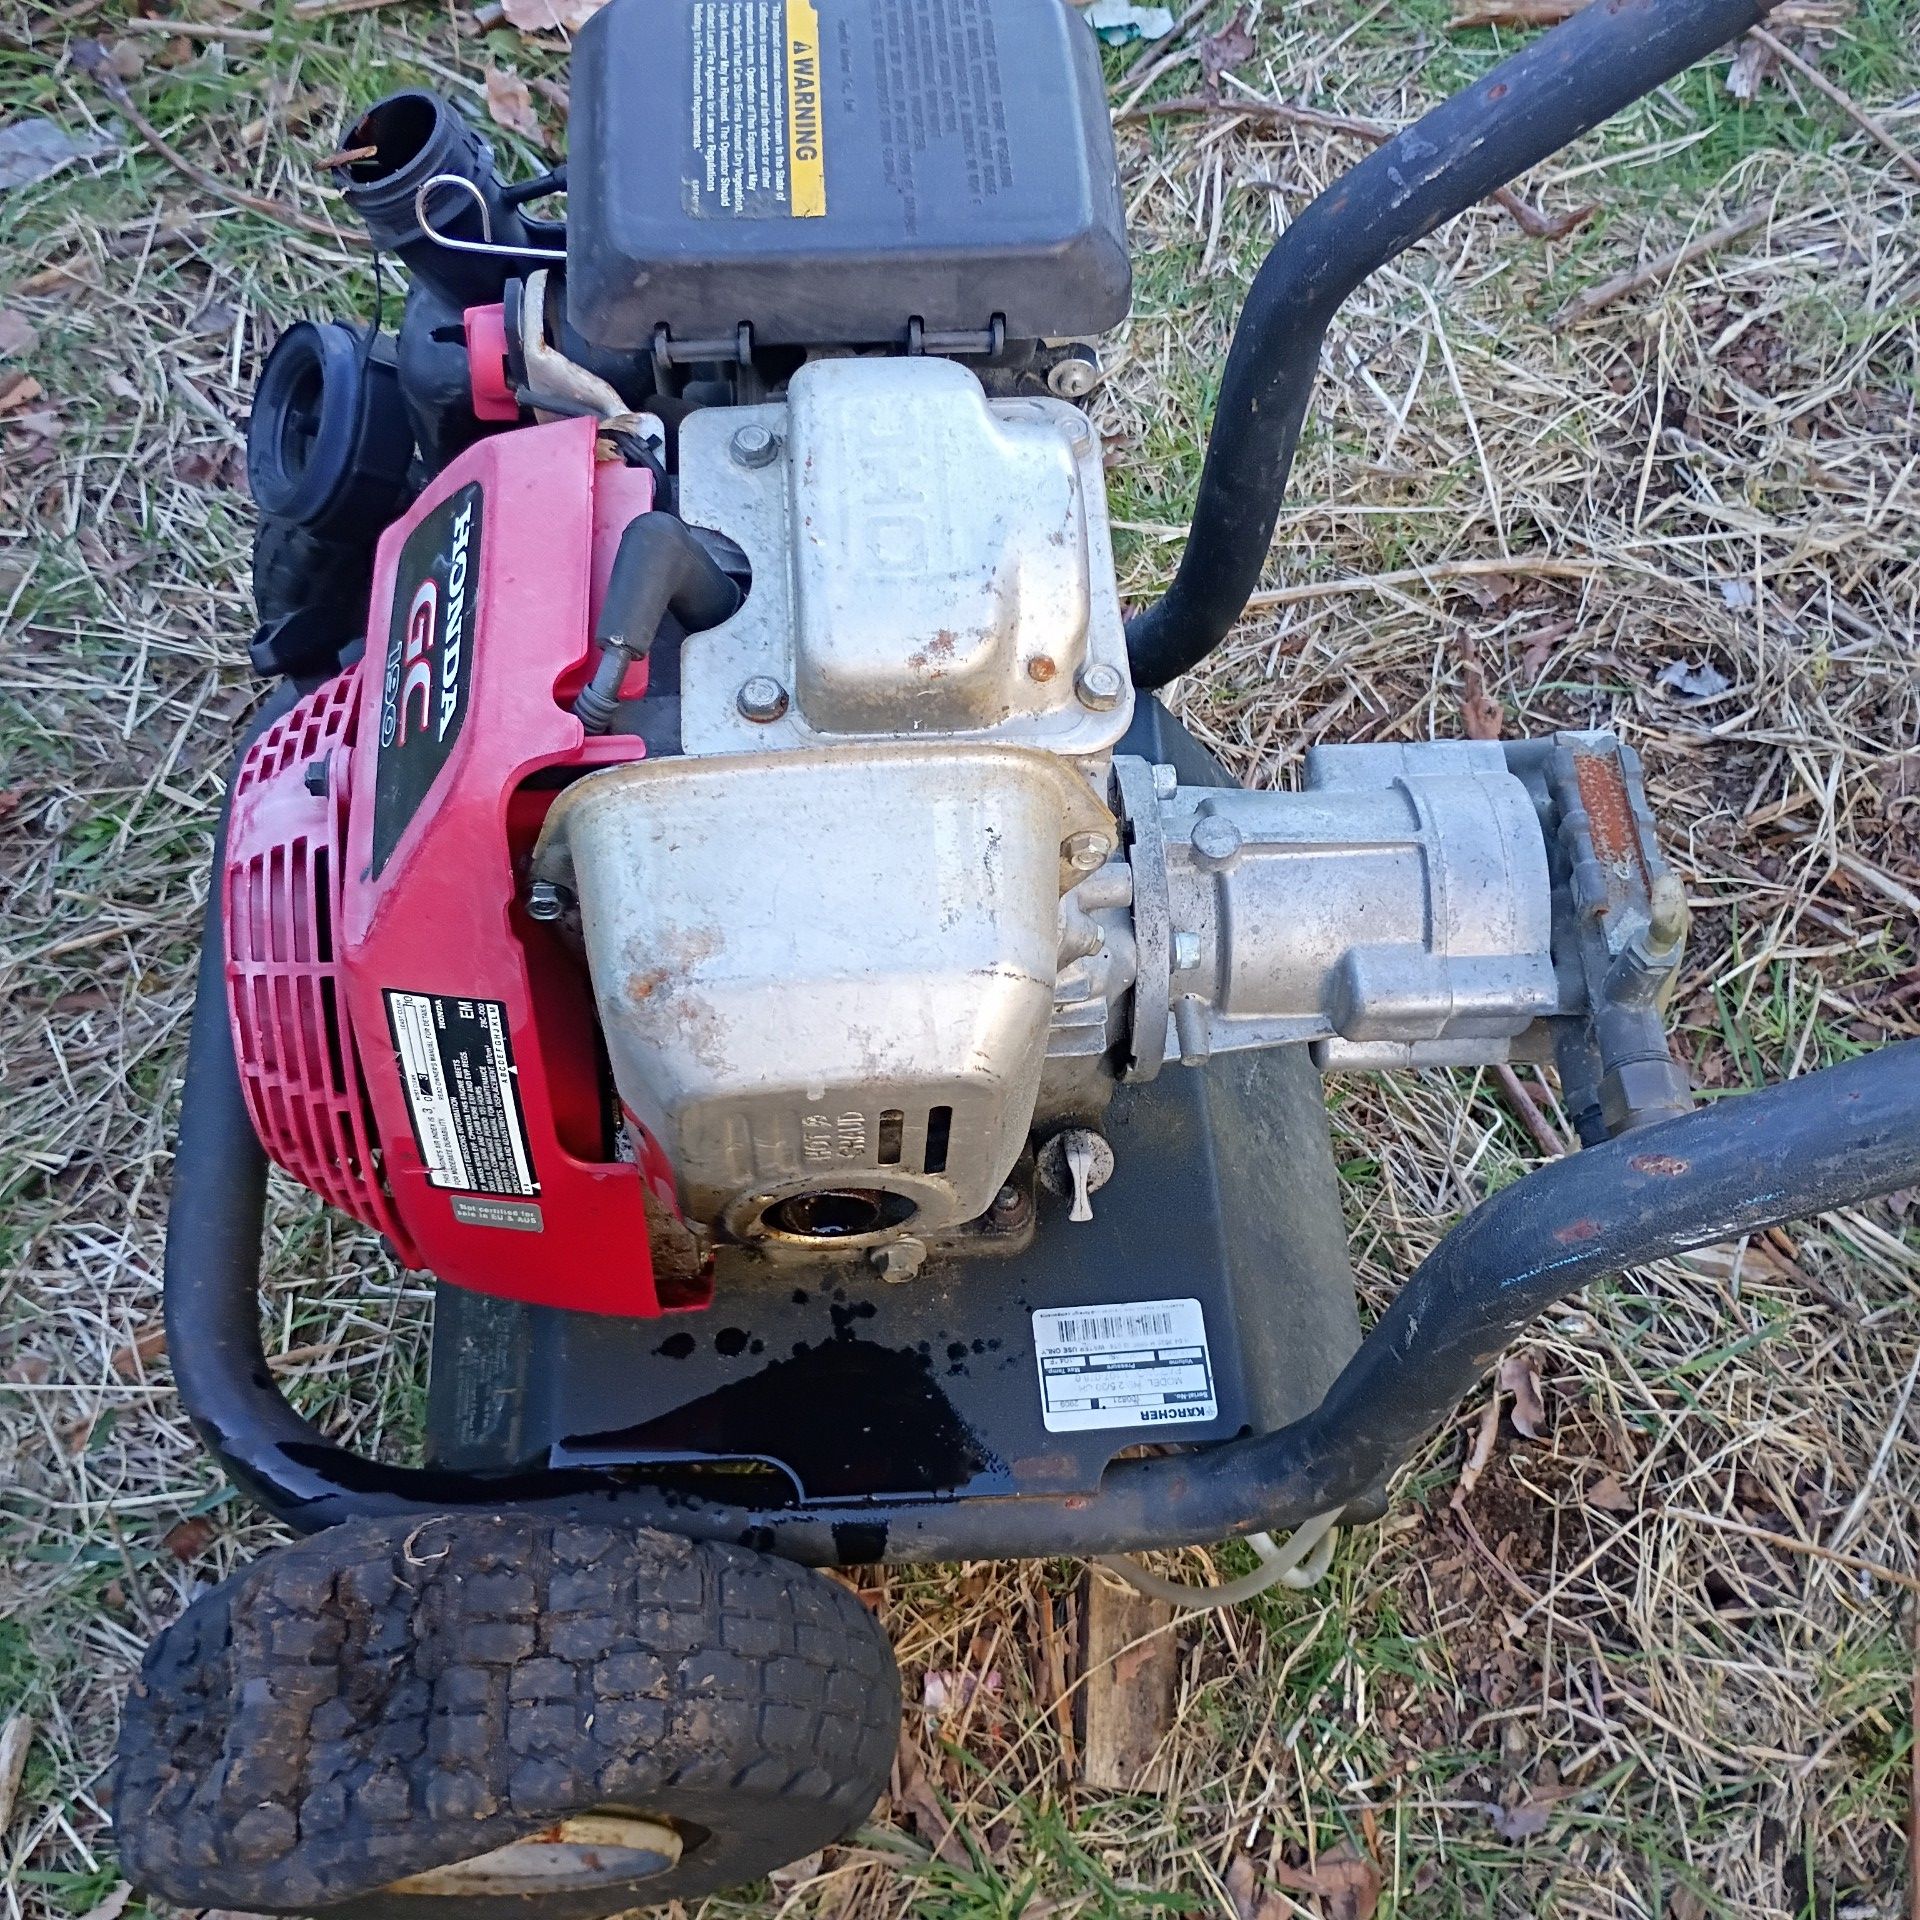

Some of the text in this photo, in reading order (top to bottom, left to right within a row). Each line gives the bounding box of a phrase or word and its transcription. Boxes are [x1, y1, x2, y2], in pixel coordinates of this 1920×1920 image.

[718, 9, 729, 28] Spark
[694, 31, 701, 40] to
[771, 20, 780, 47] product
[693, 40, 702, 54] Fire
[693, 55, 702, 94] Prevention
[718, 60, 729, 74] May
[773, 49, 782, 79] contains
[720, 76, 729, 85] be
[745, 67, 756, 103] Operation
[704, 3, 716, 191] Contact Local Fire Agencies for Laws or Regulations
[719, 87, 730, 122] Required.
[731, 2, 744, 213] Create Sparks That Can Start Fires Around Dry Vegetation.
[747, 104, 755, 112] of
[760, 92, 768, 107] and
[773, 80, 783, 117] chemicals
[793, 57, 816, 160] WARNING
[747, 114, 756, 129] This
[761, 108, 770, 125] birth
[720, 126, 729, 139] The
[761, 127, 770, 154] defects
[774, 120, 783, 144] known
[718, 141, 730, 175] Operator
[745, 131, 757, 172] Equipment
[761, 157, 768, 165] or
[775, 146, 783, 154] to
[775, 156, 784, 167] the
[746, 174, 757, 190] May
[762, 166, 770, 188] other
[775, 169, 785, 190] State
[720, 177, 730, 206] Should
[776, 192, 785, 200] of
[438, 502, 472, 742] HONDA
[397, 579, 439, 746] GC
[381, 641, 402, 748] 190
[403, 995, 413, 1004] 10
[457, 1000, 475, 1019] EM
[433, 998, 447, 1029] HONDA
[449, 1096, 464, 1133] INFORMATION
[458, 1134, 471, 1162] EMISSIONS
[803, 1132, 831, 1160] HOT
[465, 1163, 478, 1190] IMPORTANT
[1147, 1376, 1183, 1387] MODEL
[1139, 1406, 1205, 1420] KÄRCHER
